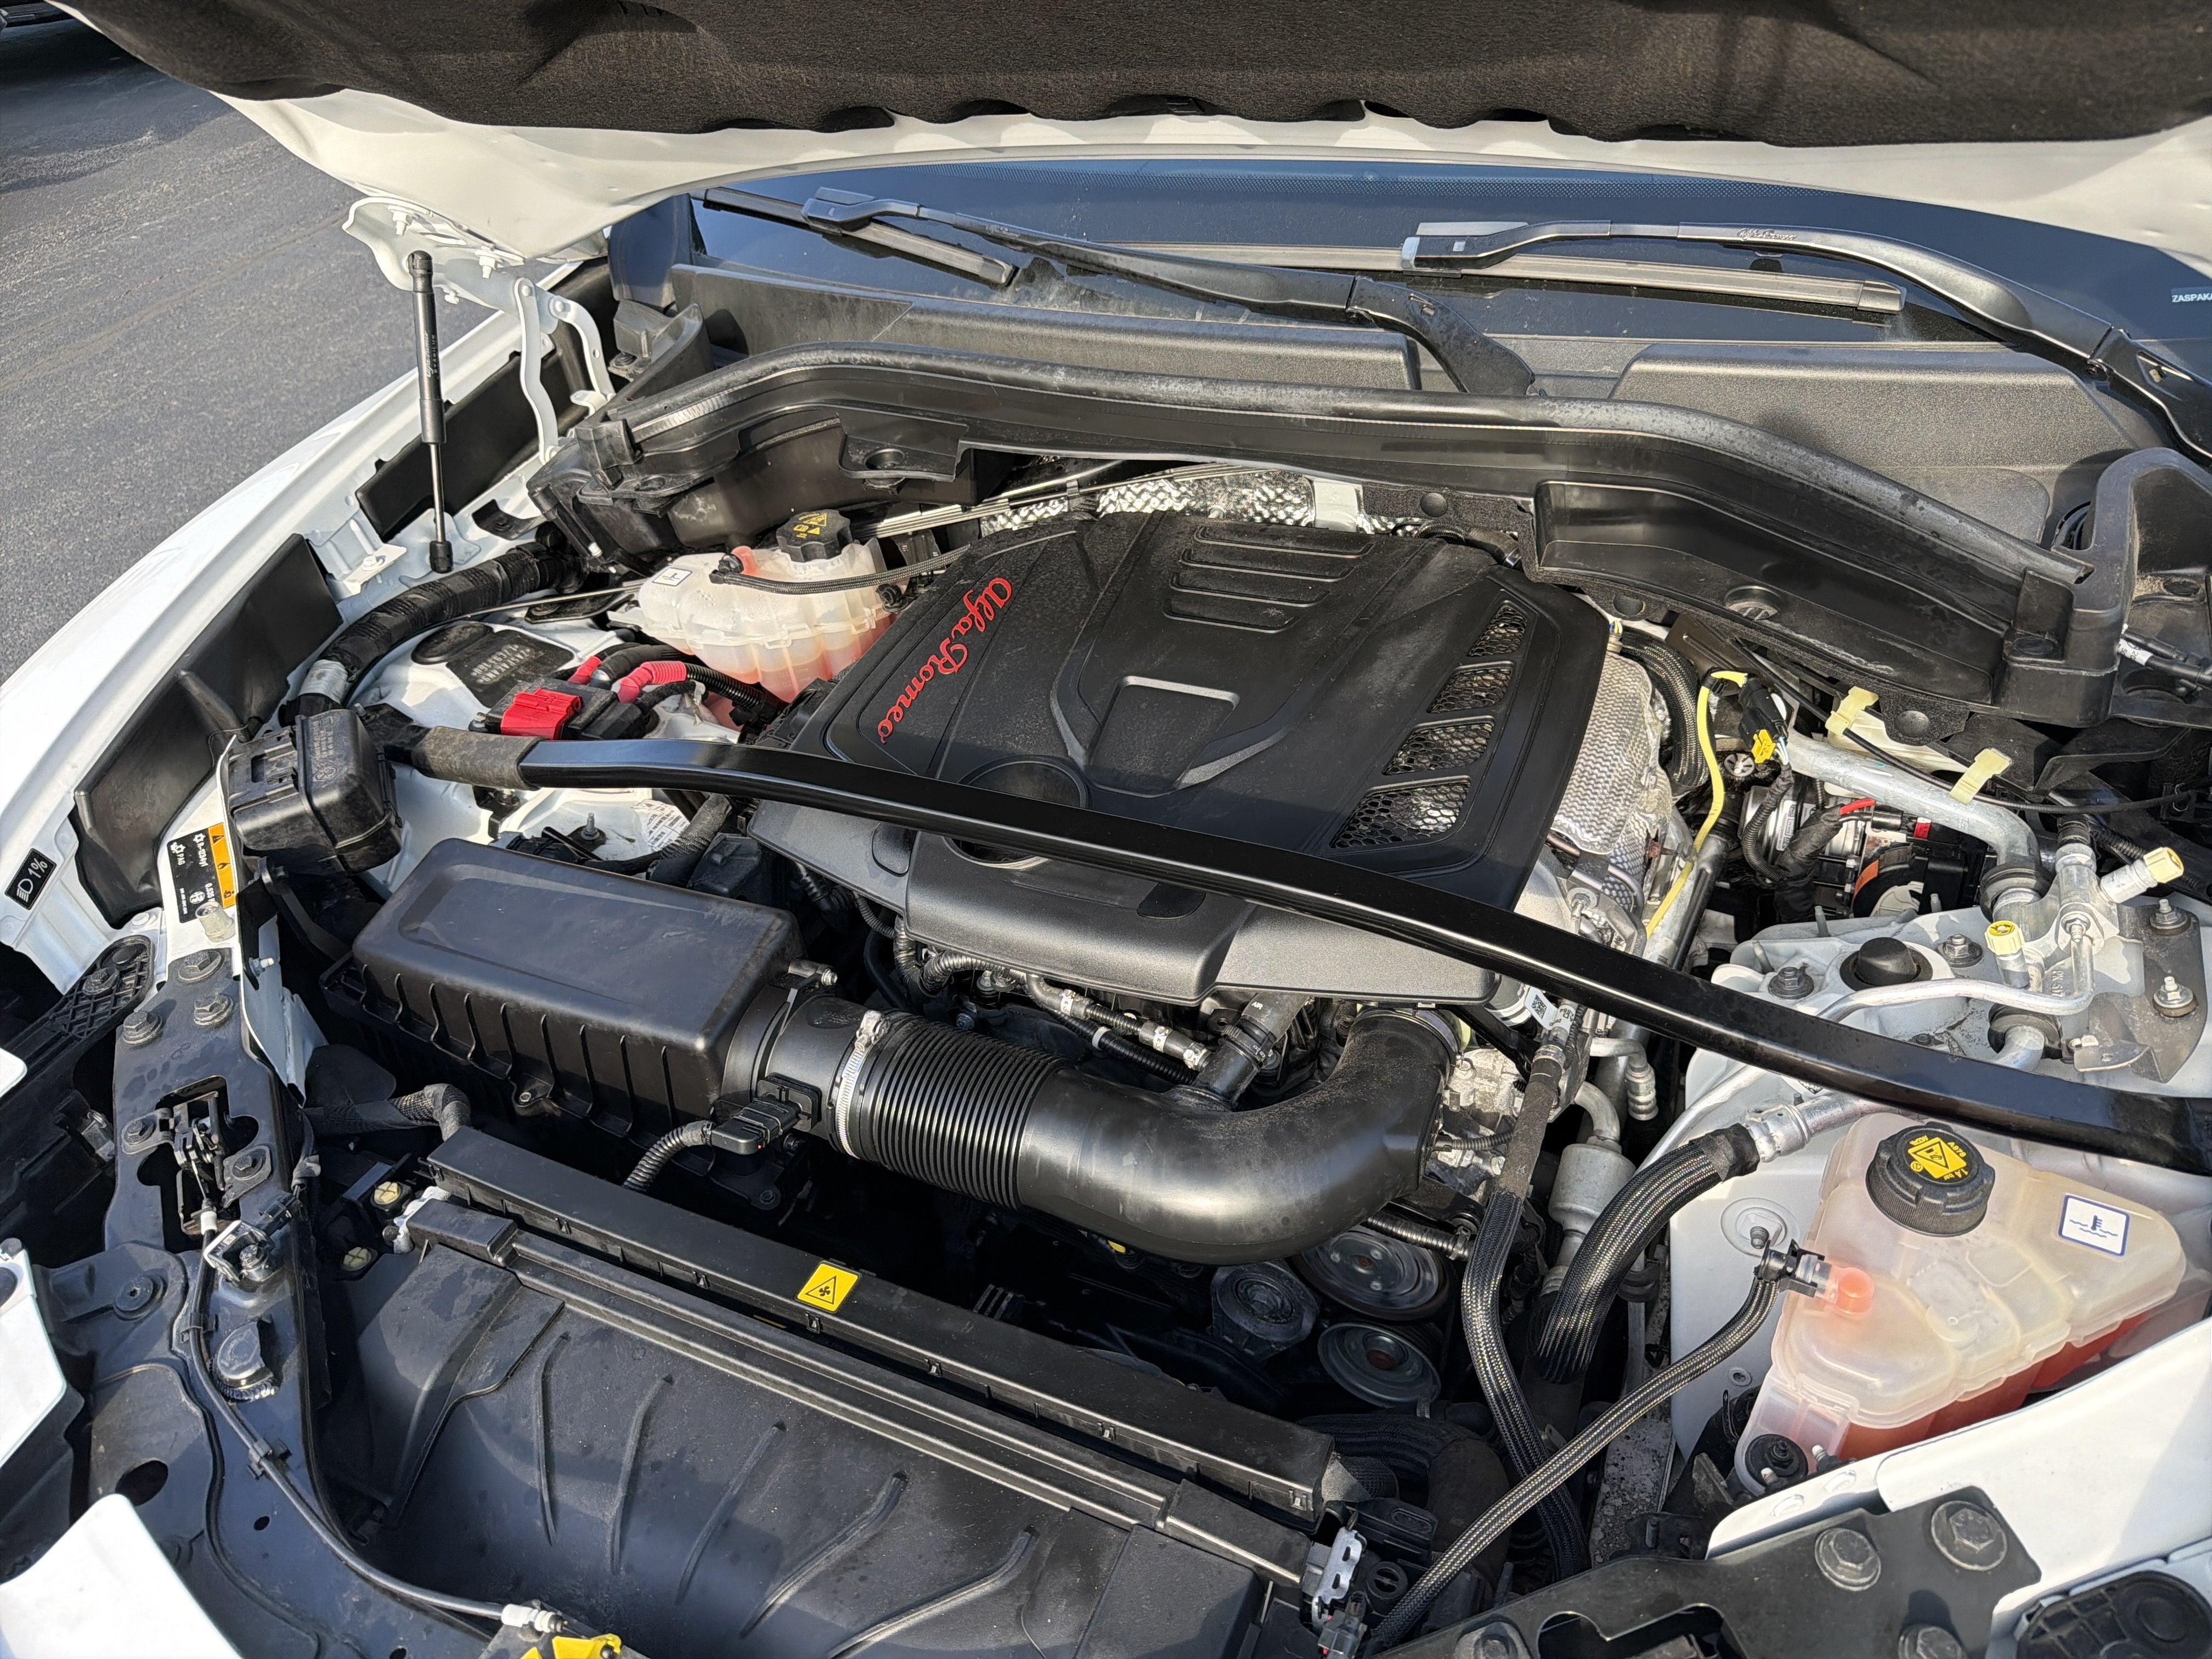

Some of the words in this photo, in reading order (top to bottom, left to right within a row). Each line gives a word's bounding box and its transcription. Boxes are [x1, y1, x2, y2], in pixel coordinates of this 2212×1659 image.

[951, 577, 1013, 639] Alfa
[878, 637, 968, 744] Romeo
[27, 857, 48, 878] 1%
[1251, 1001, 1263, 1010] AIR
